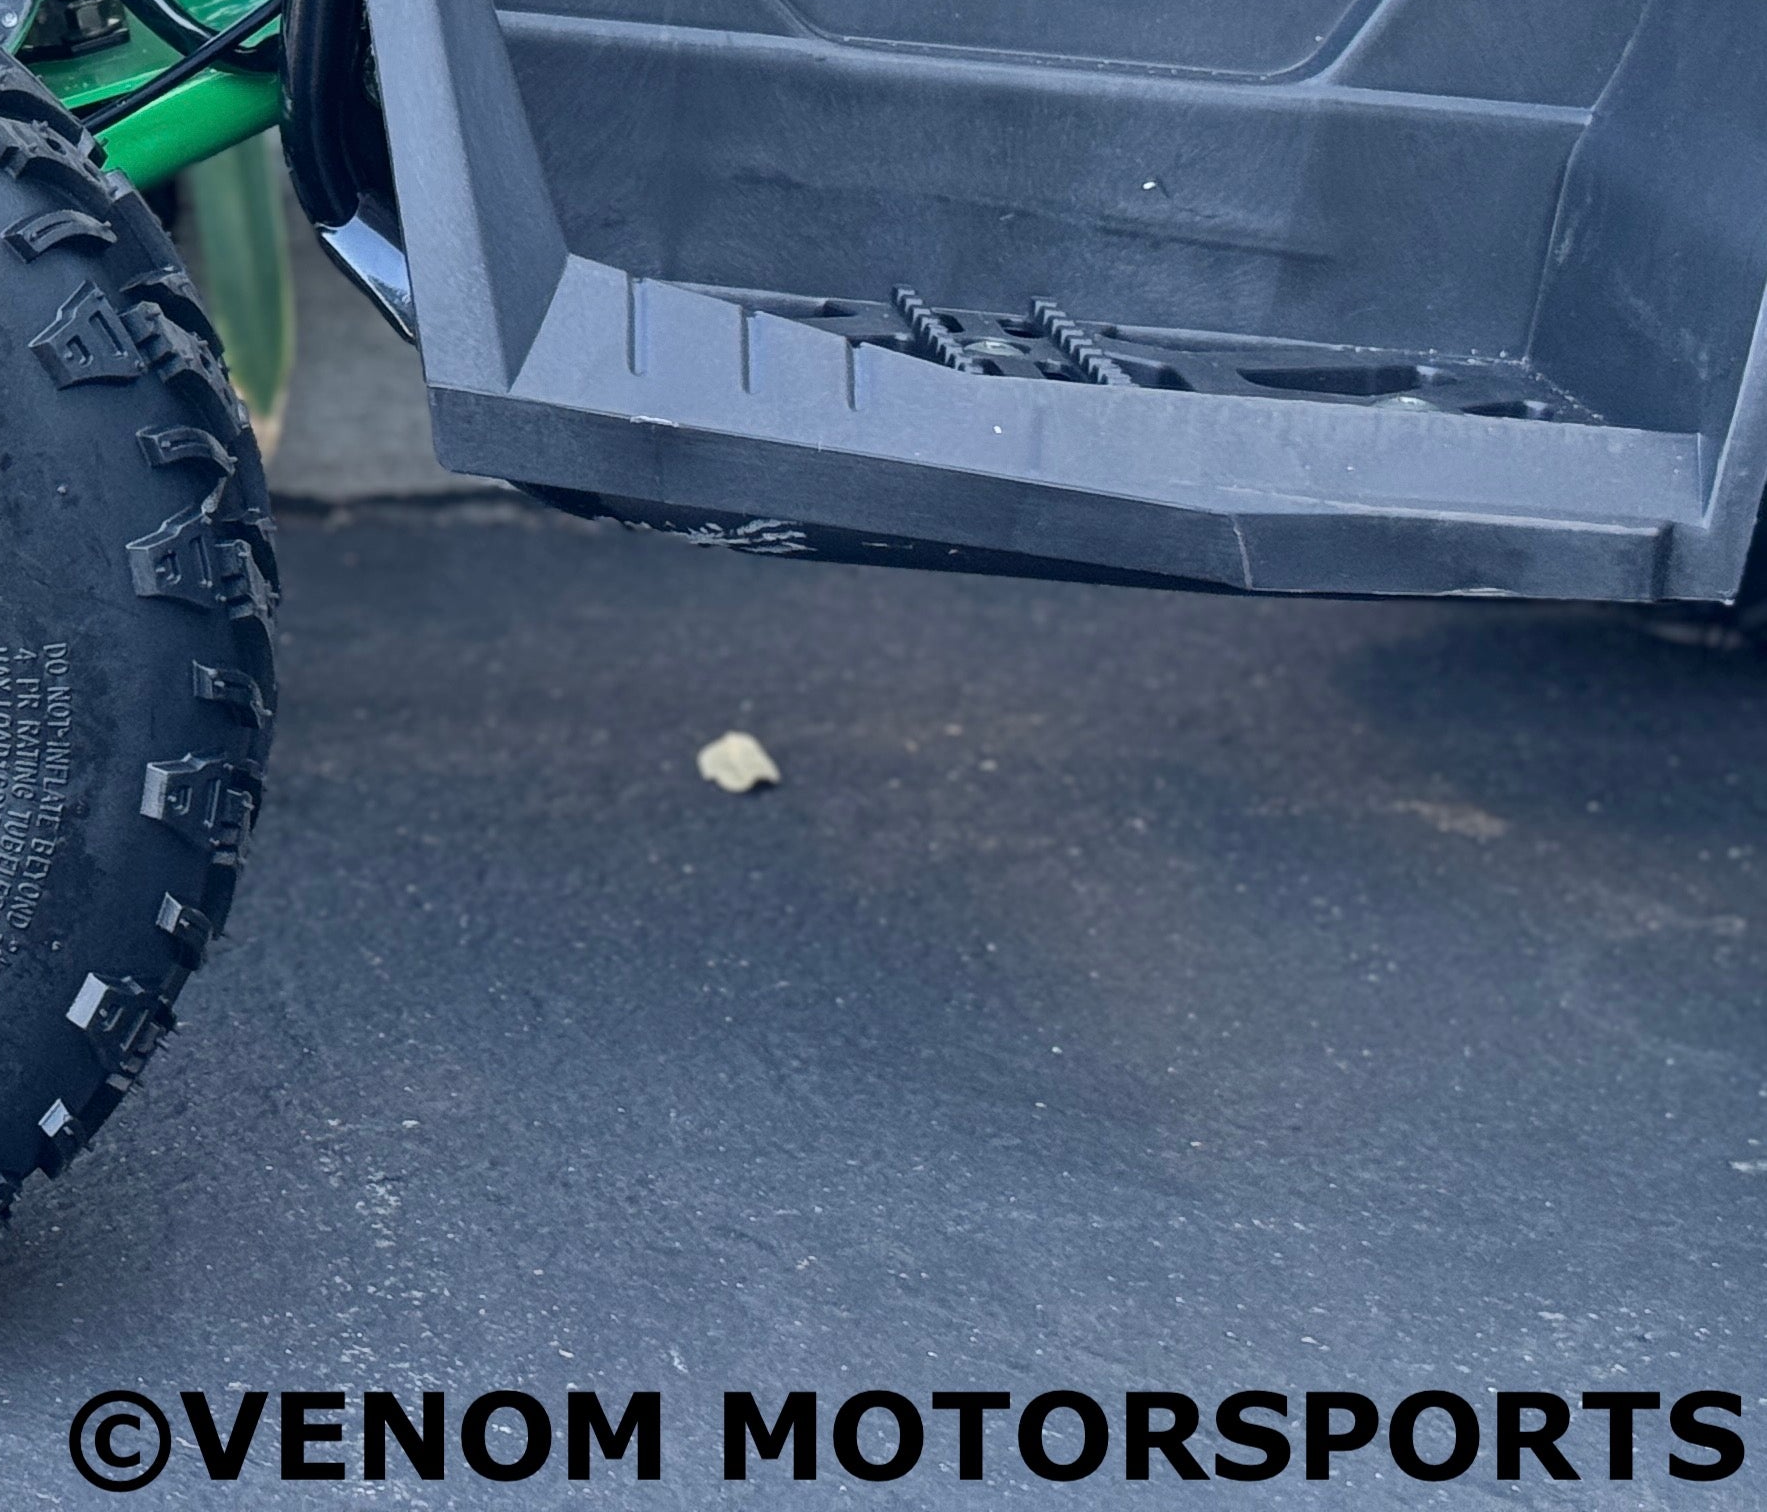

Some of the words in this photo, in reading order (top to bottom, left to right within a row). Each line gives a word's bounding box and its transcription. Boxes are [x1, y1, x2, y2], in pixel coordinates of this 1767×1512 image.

[44, 642, 69, 674] DO
[47, 685, 71, 735] NOT
[12, 719, 39, 801] RATING
[38, 739, 70, 830] INFLATE
[6, 836, 53, 930] BEYOND
